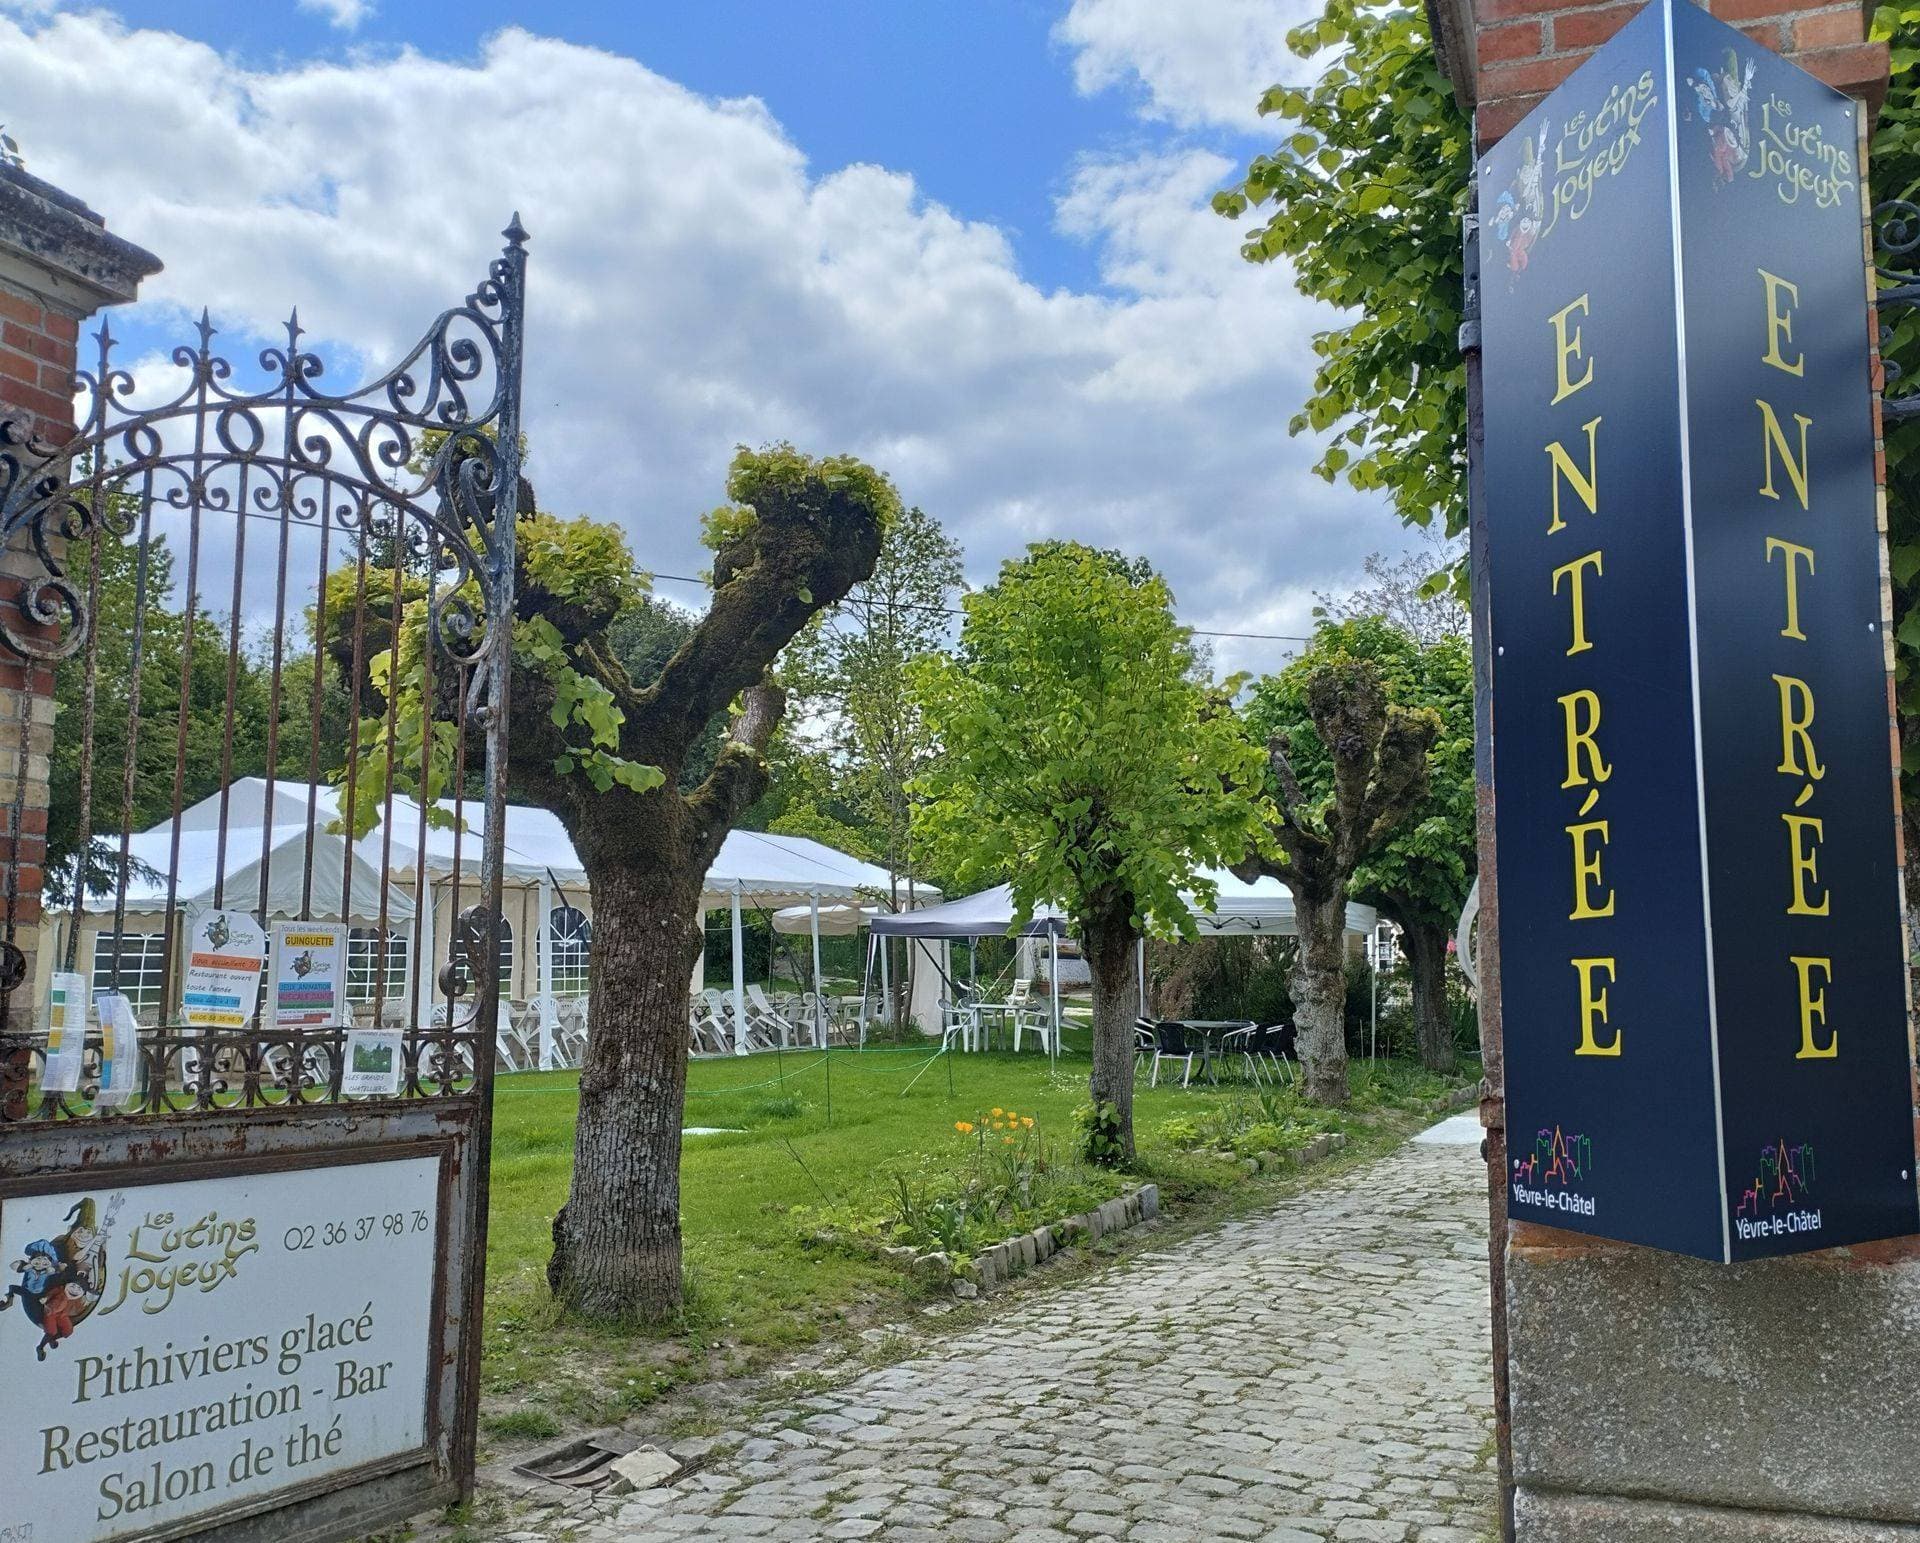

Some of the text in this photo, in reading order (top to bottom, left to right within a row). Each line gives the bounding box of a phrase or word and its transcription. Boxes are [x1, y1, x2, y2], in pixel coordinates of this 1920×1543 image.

[1555, 70, 1658, 176] Lutins
[1564, 110, 1586, 138] Les
[1771, 93, 1792, 117] Les
[1761, 102, 1854, 187] Lutins
[1541, 128, 1642, 238] Joyeux
[1748, 139, 1843, 208] Joyeux
[1545, 293, 1622, 1056] ENTRÉE
[1756, 267, 1838, 1059] ENTRÉE
[285, 936, 334, 946] GUINGUETTE
[186, 984, 206, 992] toute
[189, 969, 253, 982] Restaurant ouvert
[143, 1211, 175, 1230] Les
[1512, 1184, 1595, 1216] Yèvre-le-Châtel
[1735, 1208, 1822, 1240] Yèvre-le-Châtel
[124, 1210, 259, 1263] Lutins
[284, 1210, 429, 1251] 02 36 37 98 76
[97, 1258, 240, 1316] Joyeux
[72, 1302, 375, 1404] Pithiviers glacé
[37, 1382, 302, 1475] Restauration
[334, 1359, 394, 1402] Bar
[97, 1414, 343, 1522] Salon de thé
